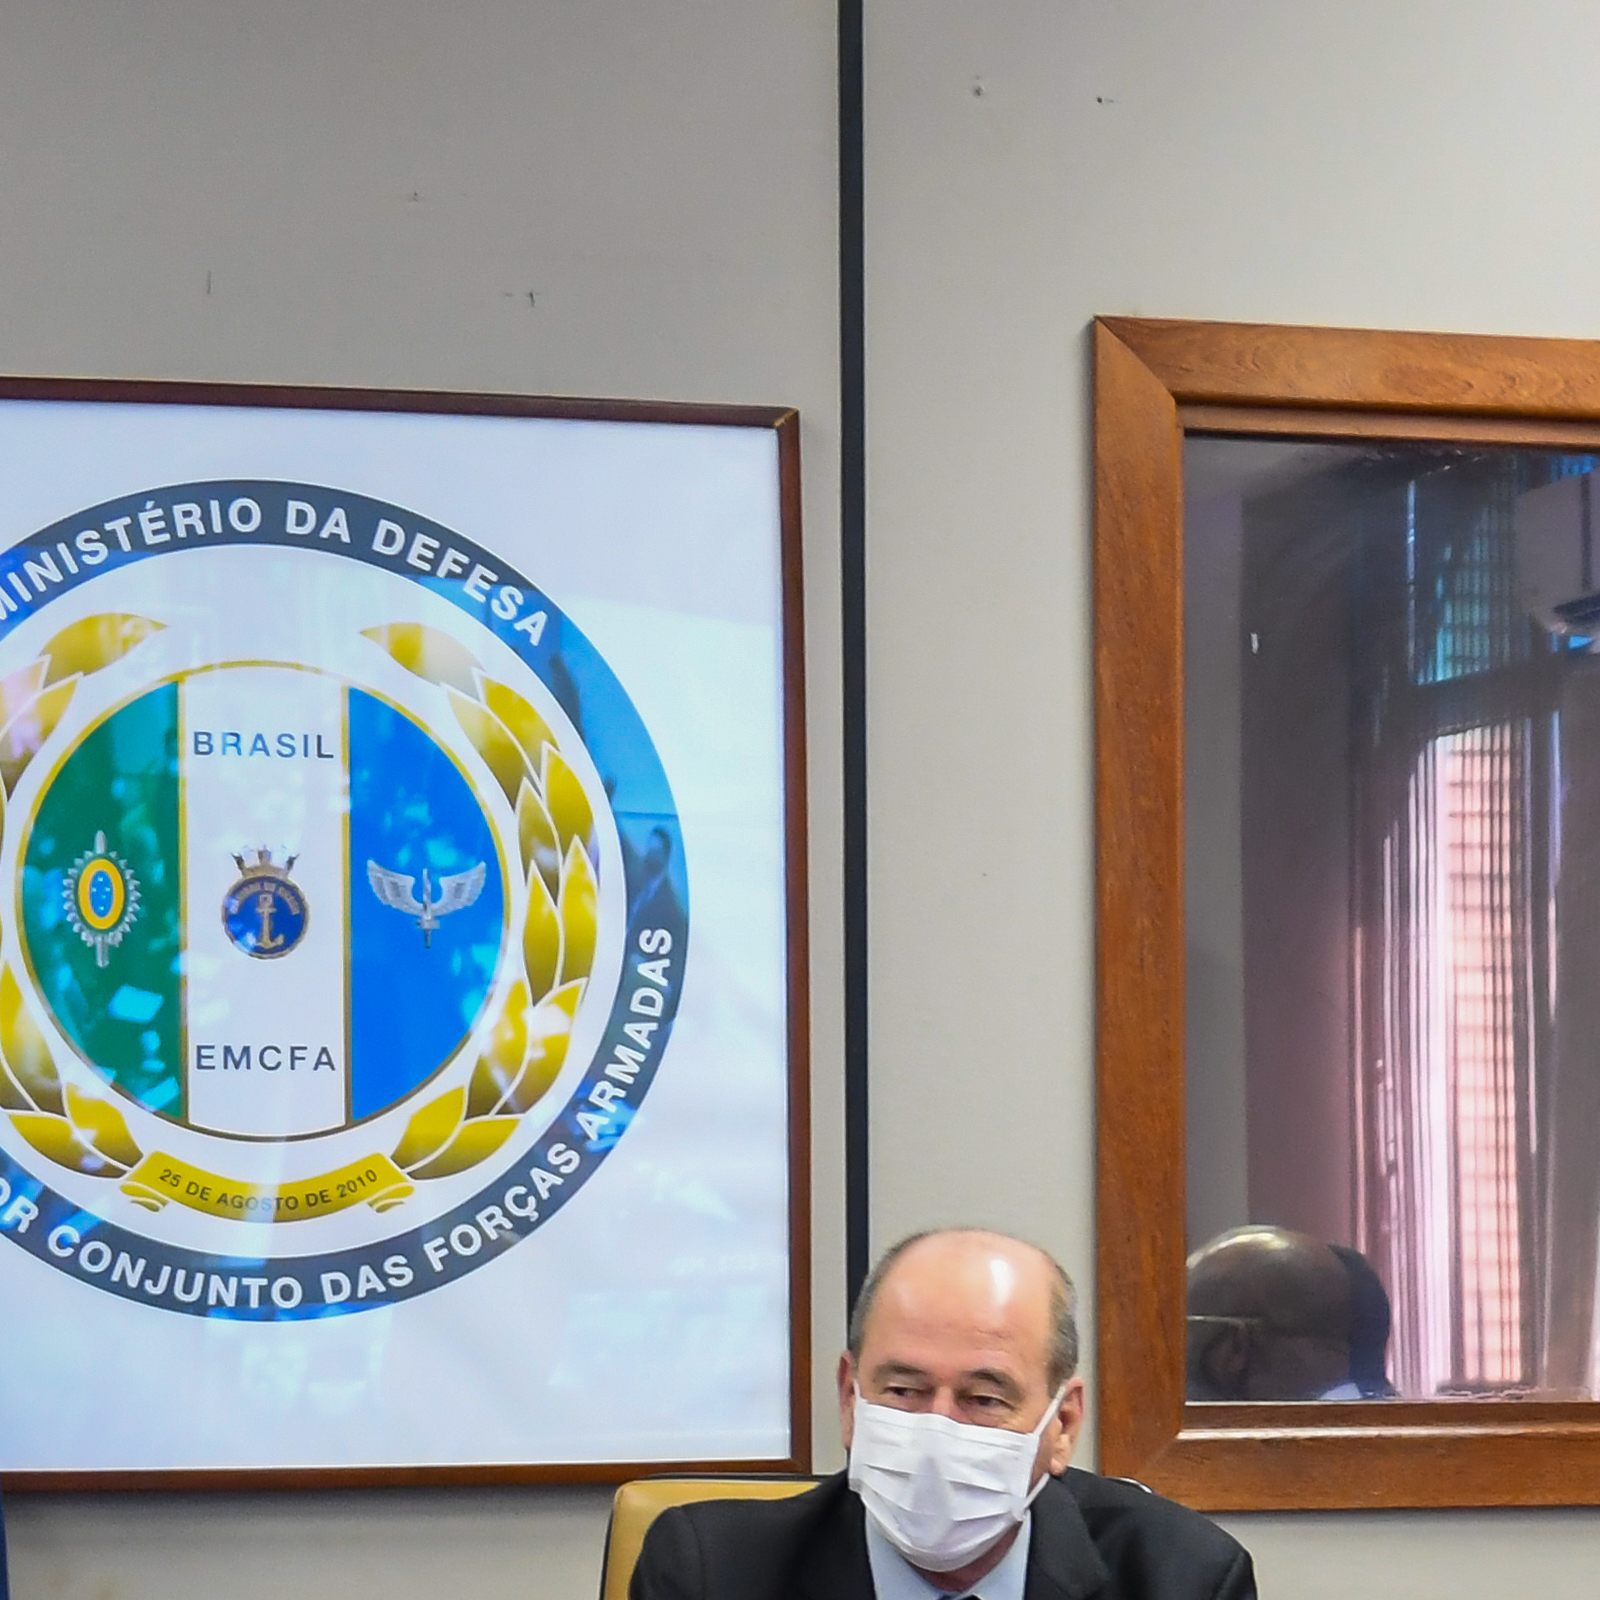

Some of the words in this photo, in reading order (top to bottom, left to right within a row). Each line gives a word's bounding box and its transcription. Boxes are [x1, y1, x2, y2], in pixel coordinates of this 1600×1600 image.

[285, 499, 351, 543] DA
[371, 518, 548, 647] DEFESA
[193, 730, 335, 759] BRASIL
[196, 1044, 336, 1071] EMCFA
[47, 1224, 302, 1309] CONJUNTO
[320, 1254, 414, 1304] DAS
[423, 1142, 581, 1273] FORÇAS
[575, 928, 673, 1141] ARMADAS
[158, 1168, 182, 1188] 25
[185, 1181, 212, 1201] DE
[216, 1192, 299, 1212] AGOSTO
[304, 1189, 332, 1208] DE
[336, 1168, 378, 1198] 2010
